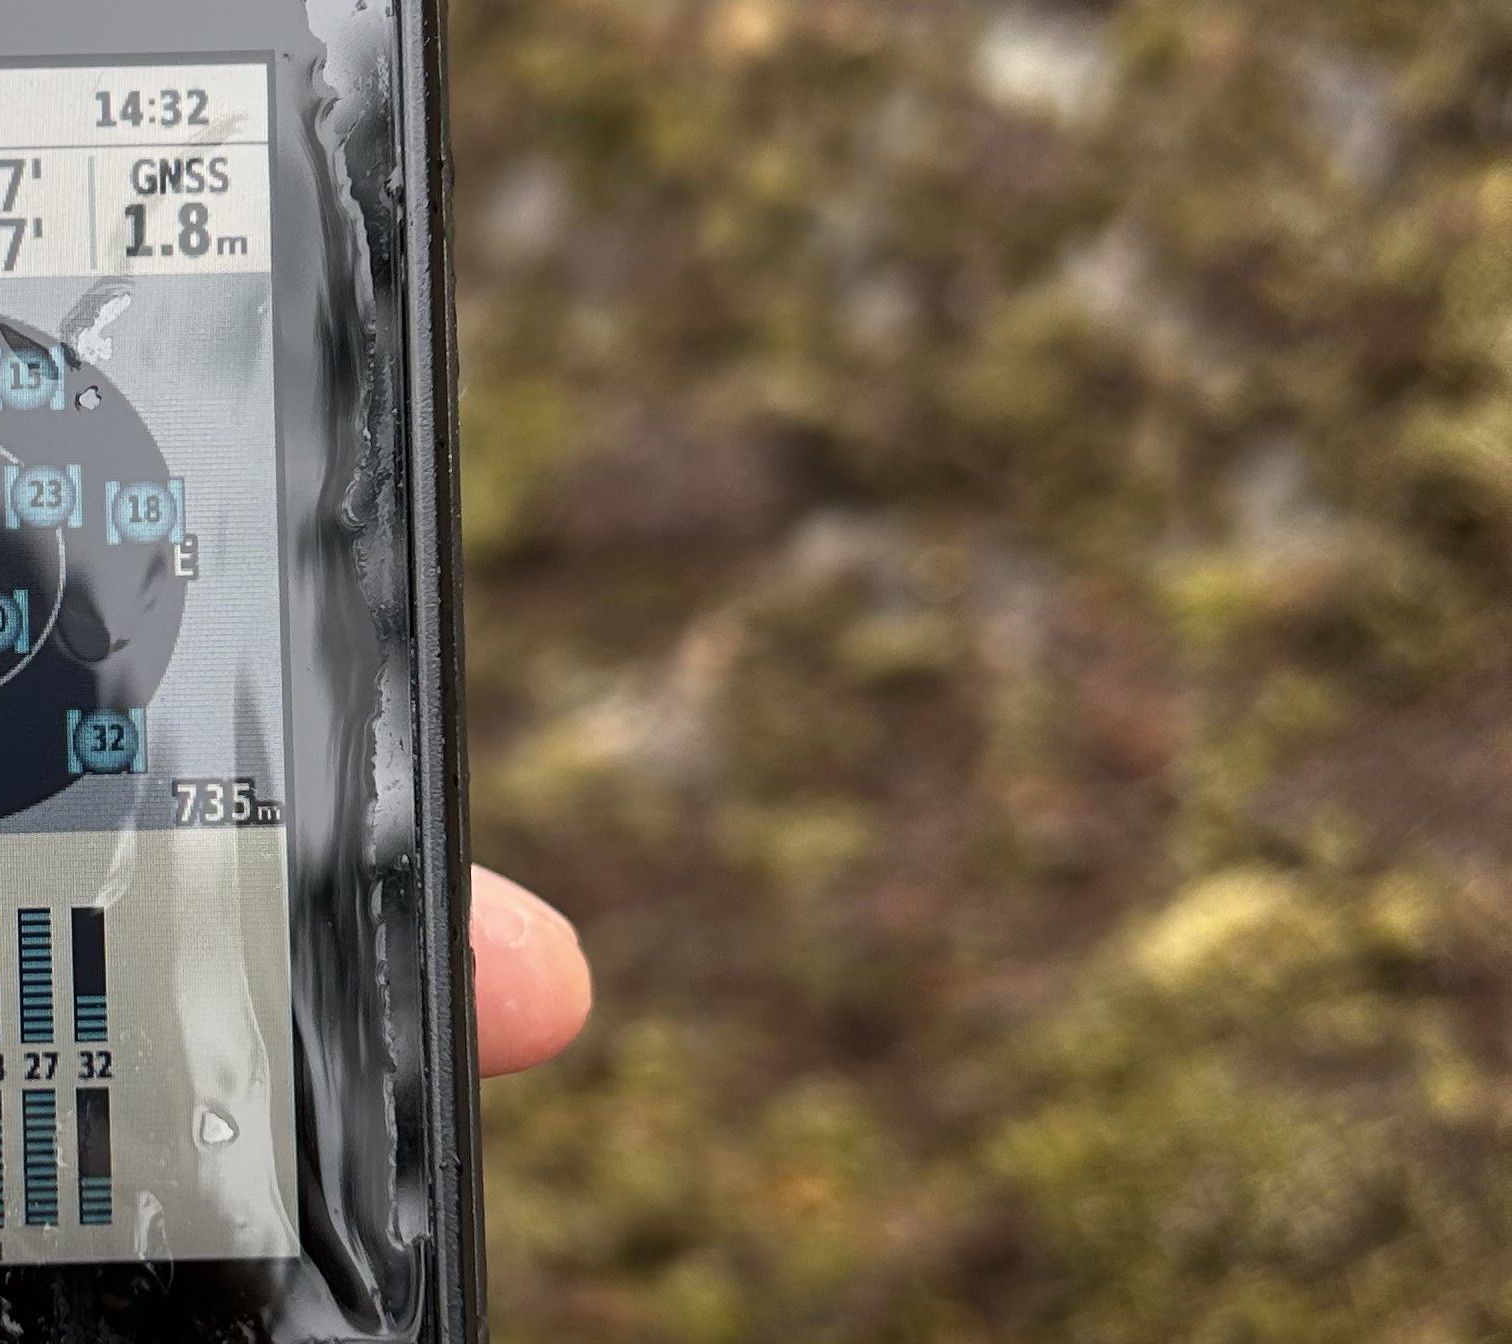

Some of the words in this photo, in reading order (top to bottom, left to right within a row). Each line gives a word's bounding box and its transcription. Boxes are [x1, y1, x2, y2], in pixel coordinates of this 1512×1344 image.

[95, 89, 210, 129] 14:32
[132, 158, 230, 195] GNSS
[10, 361, 41, 389] 15
[31, 479, 62, 507] 23
[130, 494, 160, 523] 18
[92, 725, 124, 751] 32
[25, 1054, 58, 1080] 27
[79, 1052, 112, 1078] 32
